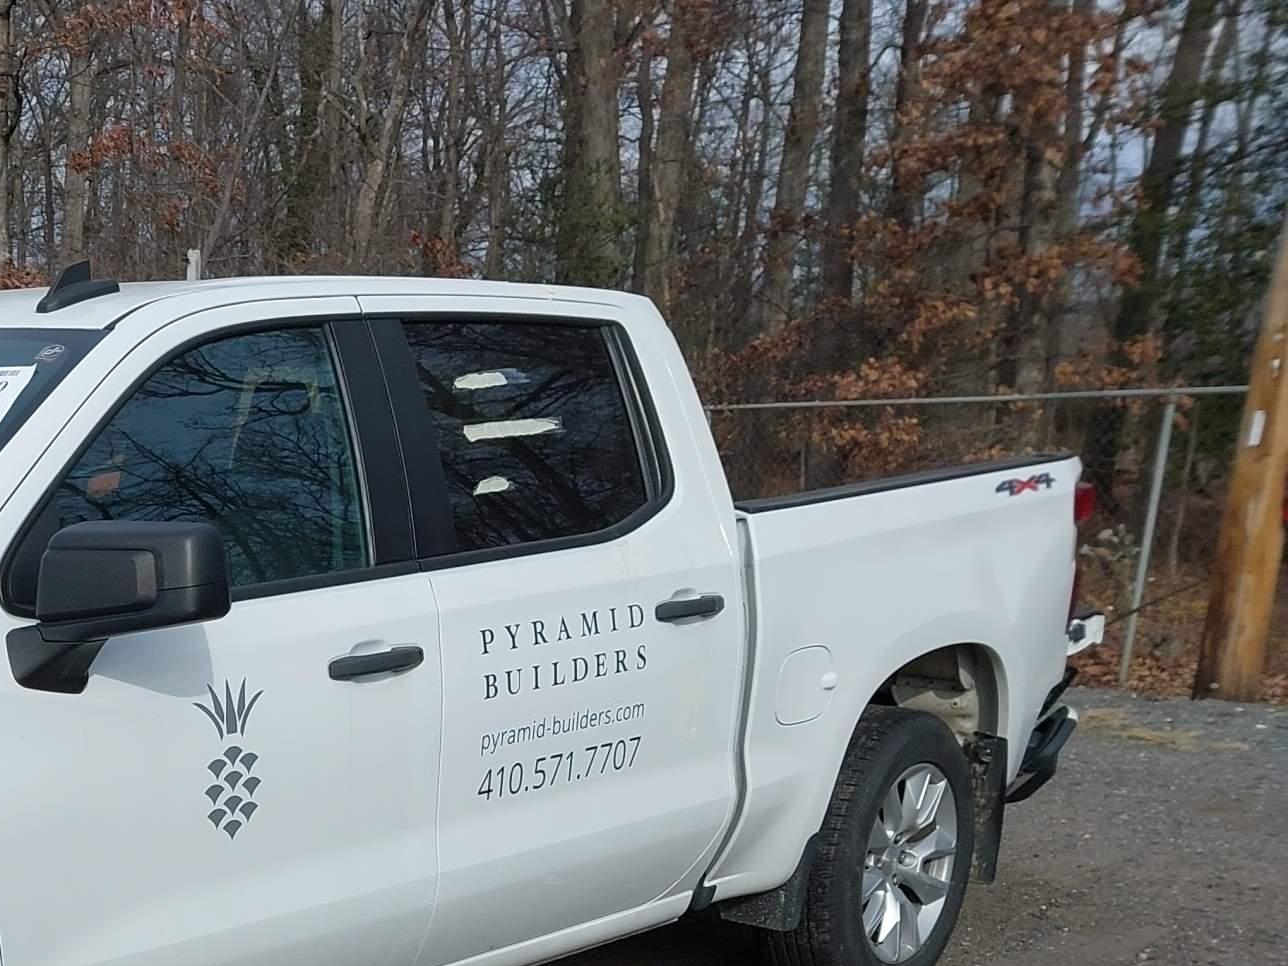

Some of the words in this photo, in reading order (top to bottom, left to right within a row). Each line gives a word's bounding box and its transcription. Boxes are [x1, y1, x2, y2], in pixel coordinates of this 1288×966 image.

[480, 604, 644, 655] PYRAMID
[483, 645, 647, 700] BUILDERS
[480, 703, 645, 756] pyramid-builders.com
[477, 736, 642, 801] 410.571.7707
